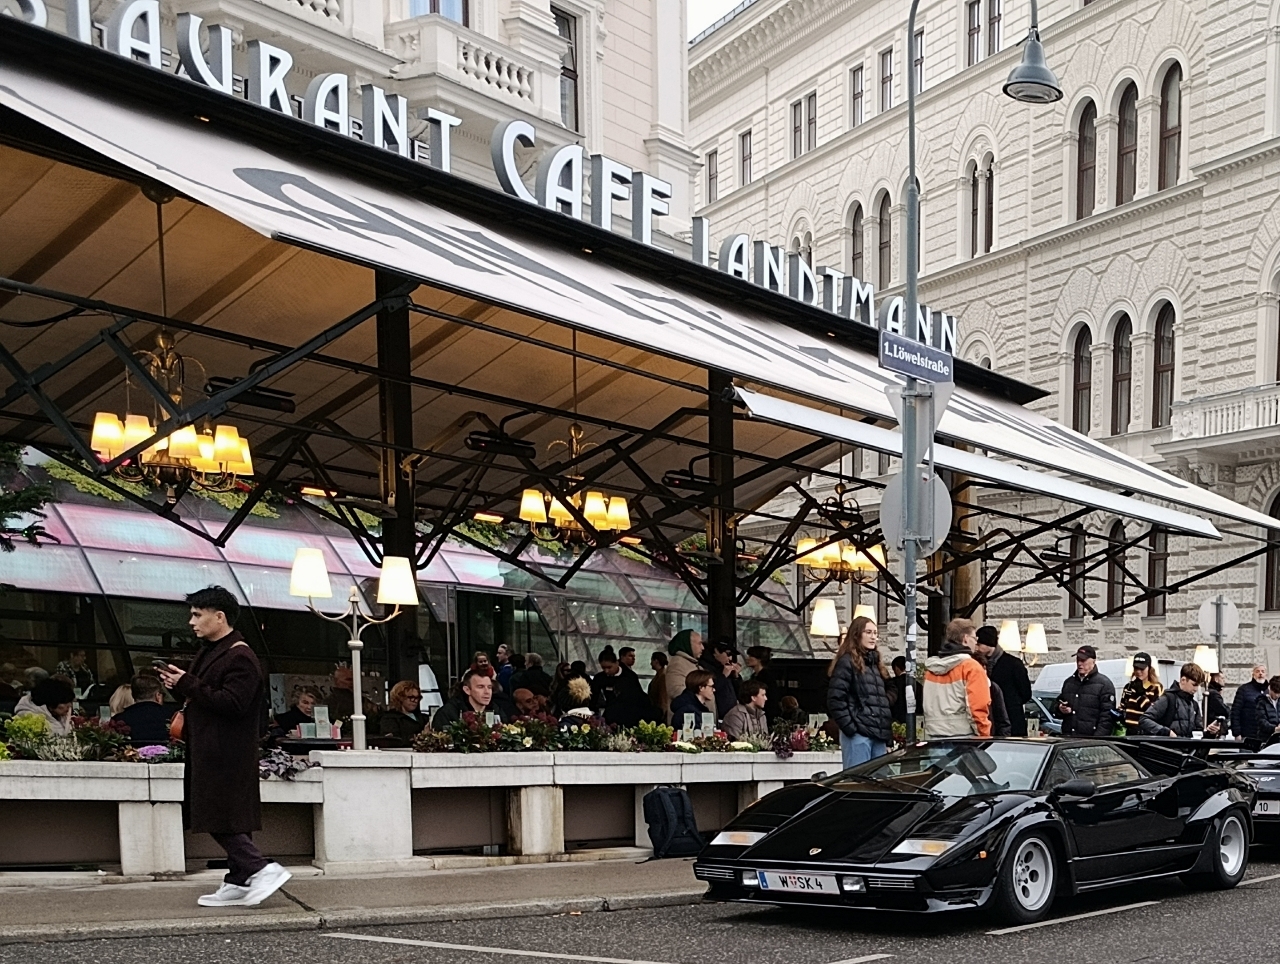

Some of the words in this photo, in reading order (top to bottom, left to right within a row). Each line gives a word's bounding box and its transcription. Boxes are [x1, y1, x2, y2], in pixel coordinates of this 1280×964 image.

[893, 344, 950, 376] Löwelstraße
[1259, 802, 1269, 812] 10
[778, 875, 789, 888] W
